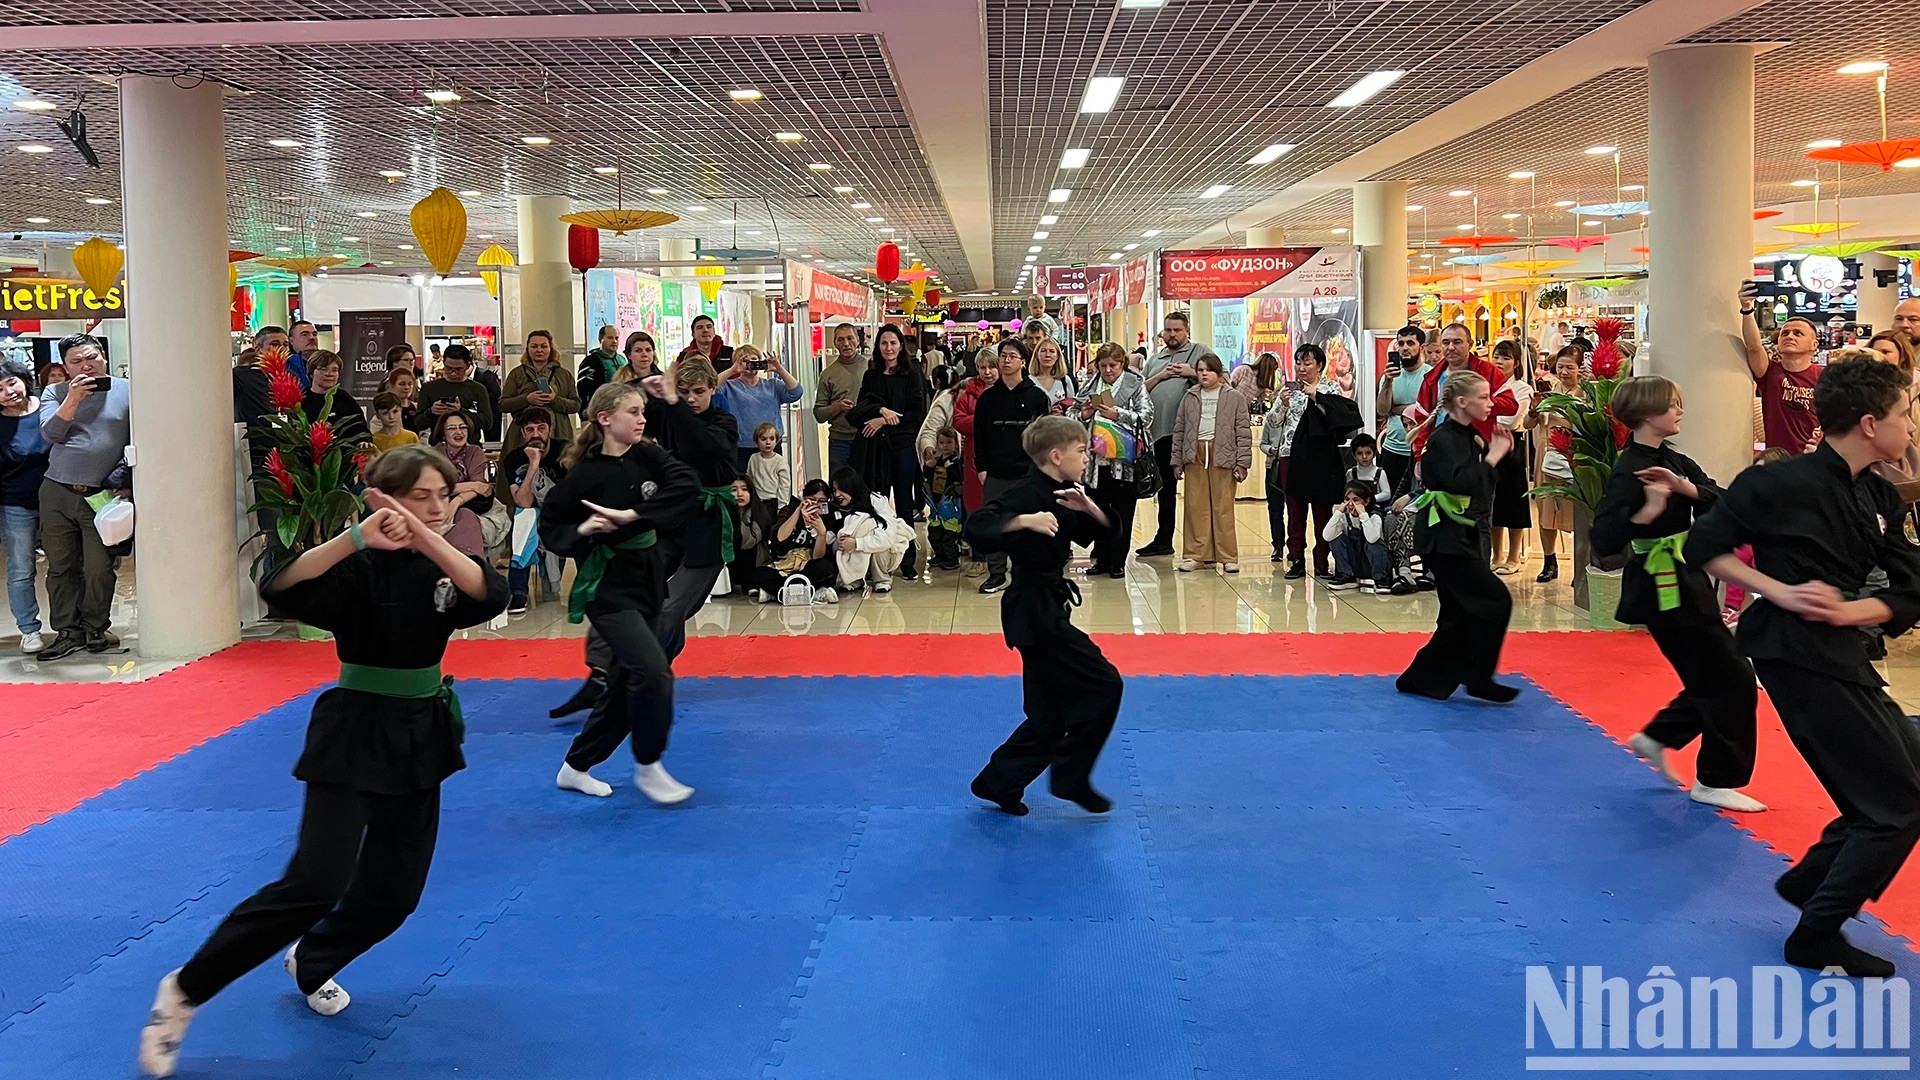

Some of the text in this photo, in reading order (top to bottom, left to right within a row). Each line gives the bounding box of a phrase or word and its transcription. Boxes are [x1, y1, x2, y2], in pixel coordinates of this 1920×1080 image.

[1170, 258, 1294, 273] ООО «ФУДЗОН»
[1324, 286, 1338, 296] 26
[355, 359, 387, 375] Legend
